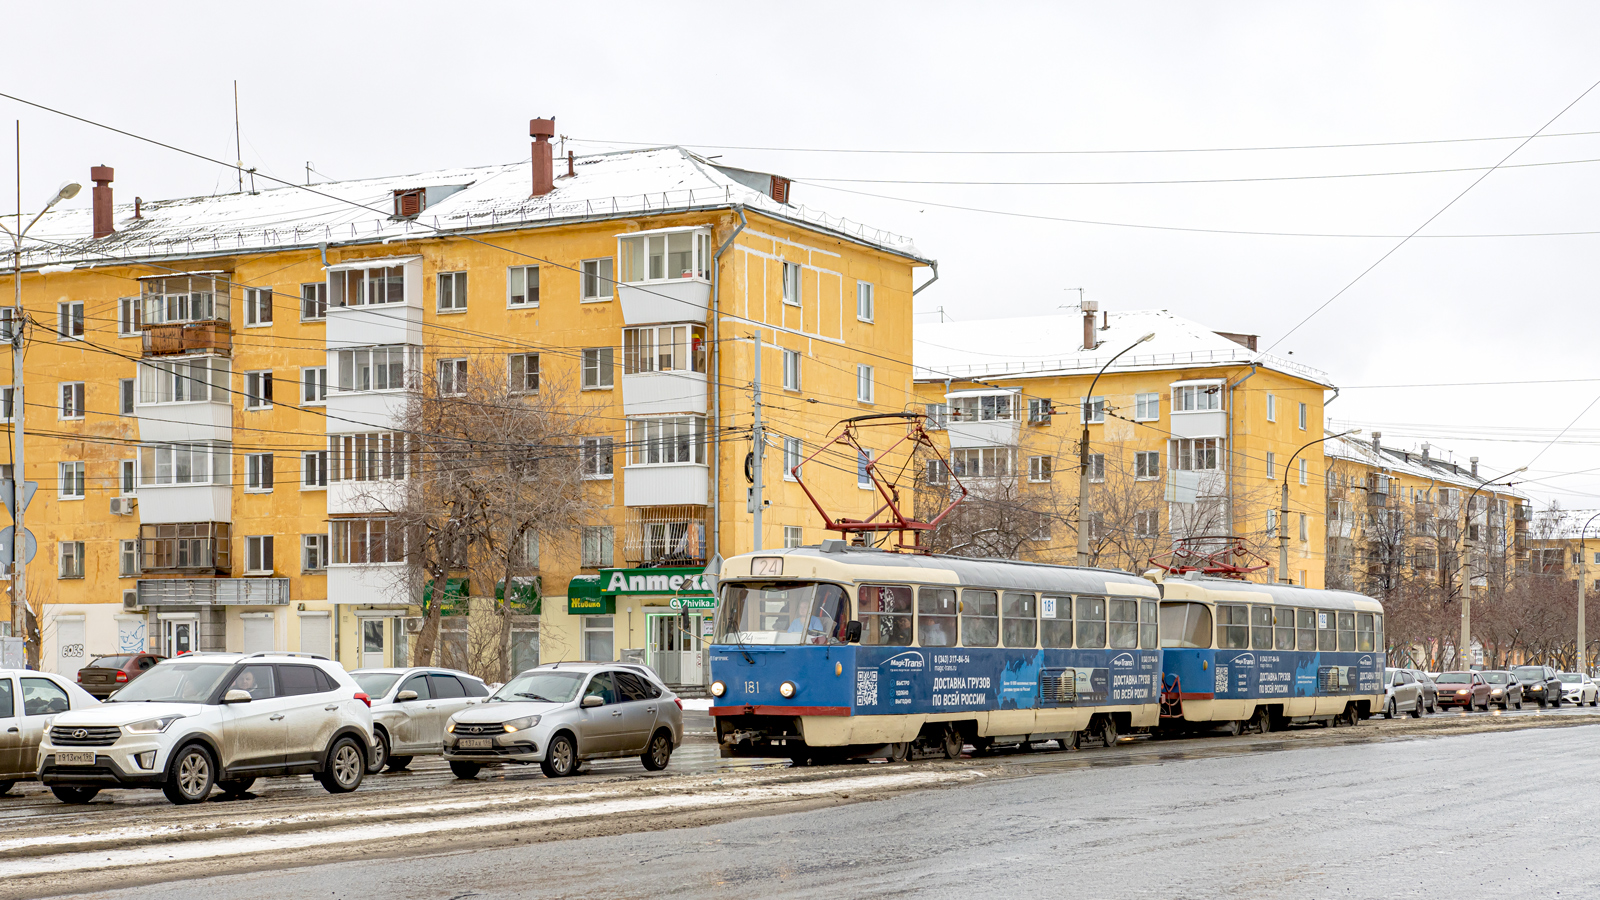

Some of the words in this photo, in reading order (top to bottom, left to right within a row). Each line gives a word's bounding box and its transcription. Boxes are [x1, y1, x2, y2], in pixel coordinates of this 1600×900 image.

[760, 559, 778, 576] 24
[1044, 600, 1053, 612] 181
[933, 677, 966, 692] ДОСТАВКА
[967, 677, 991, 689] ГРУЗОВ
[1113, 675, 1138, 688] ДОСТАВКА
[1259, 672, 1277, 683] ДОСТАВКА
[744, 680, 760, 694] 181
[1113, 689, 1120, 700] ПО
[1121, 686, 1134, 700] ВСЕЙ
[1259, 685, 1264, 693] ПО
[1264, 682, 1274, 693] ВСЕЙ
[933, 694, 942, 706] ПО
[943, 691, 960, 706] ВСЕЙ
[961, 693, 986, 705] РОССИИ
